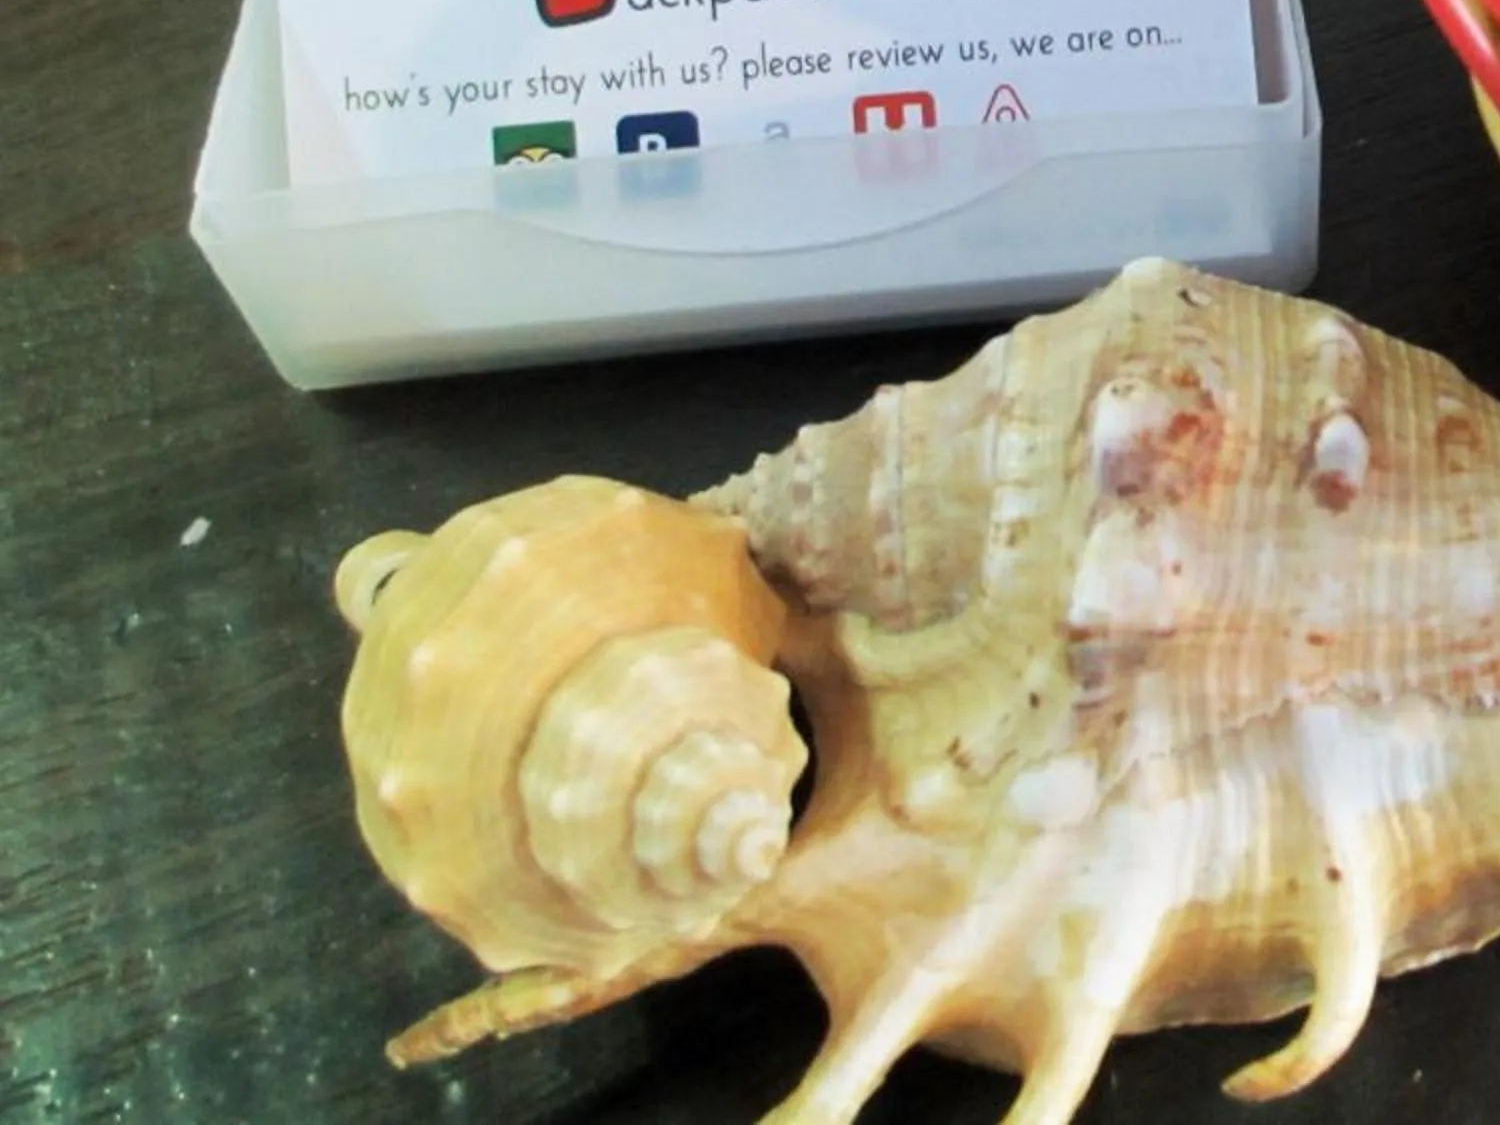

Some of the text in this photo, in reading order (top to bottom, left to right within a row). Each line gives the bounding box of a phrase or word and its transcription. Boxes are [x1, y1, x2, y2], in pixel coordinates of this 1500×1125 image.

[344, 74, 431, 112] how's
[443, 77, 513, 115] your
[526, 66, 586, 105] stay
[599, 50, 666, 91] with
[680, 45, 729, 84] us?
[741, 42, 832, 90] please
[846, 39, 944, 71] review
[958, 36, 998, 65] us,
[1010, 29, 1055, 57] we
[1066, 27, 1115, 53] are
